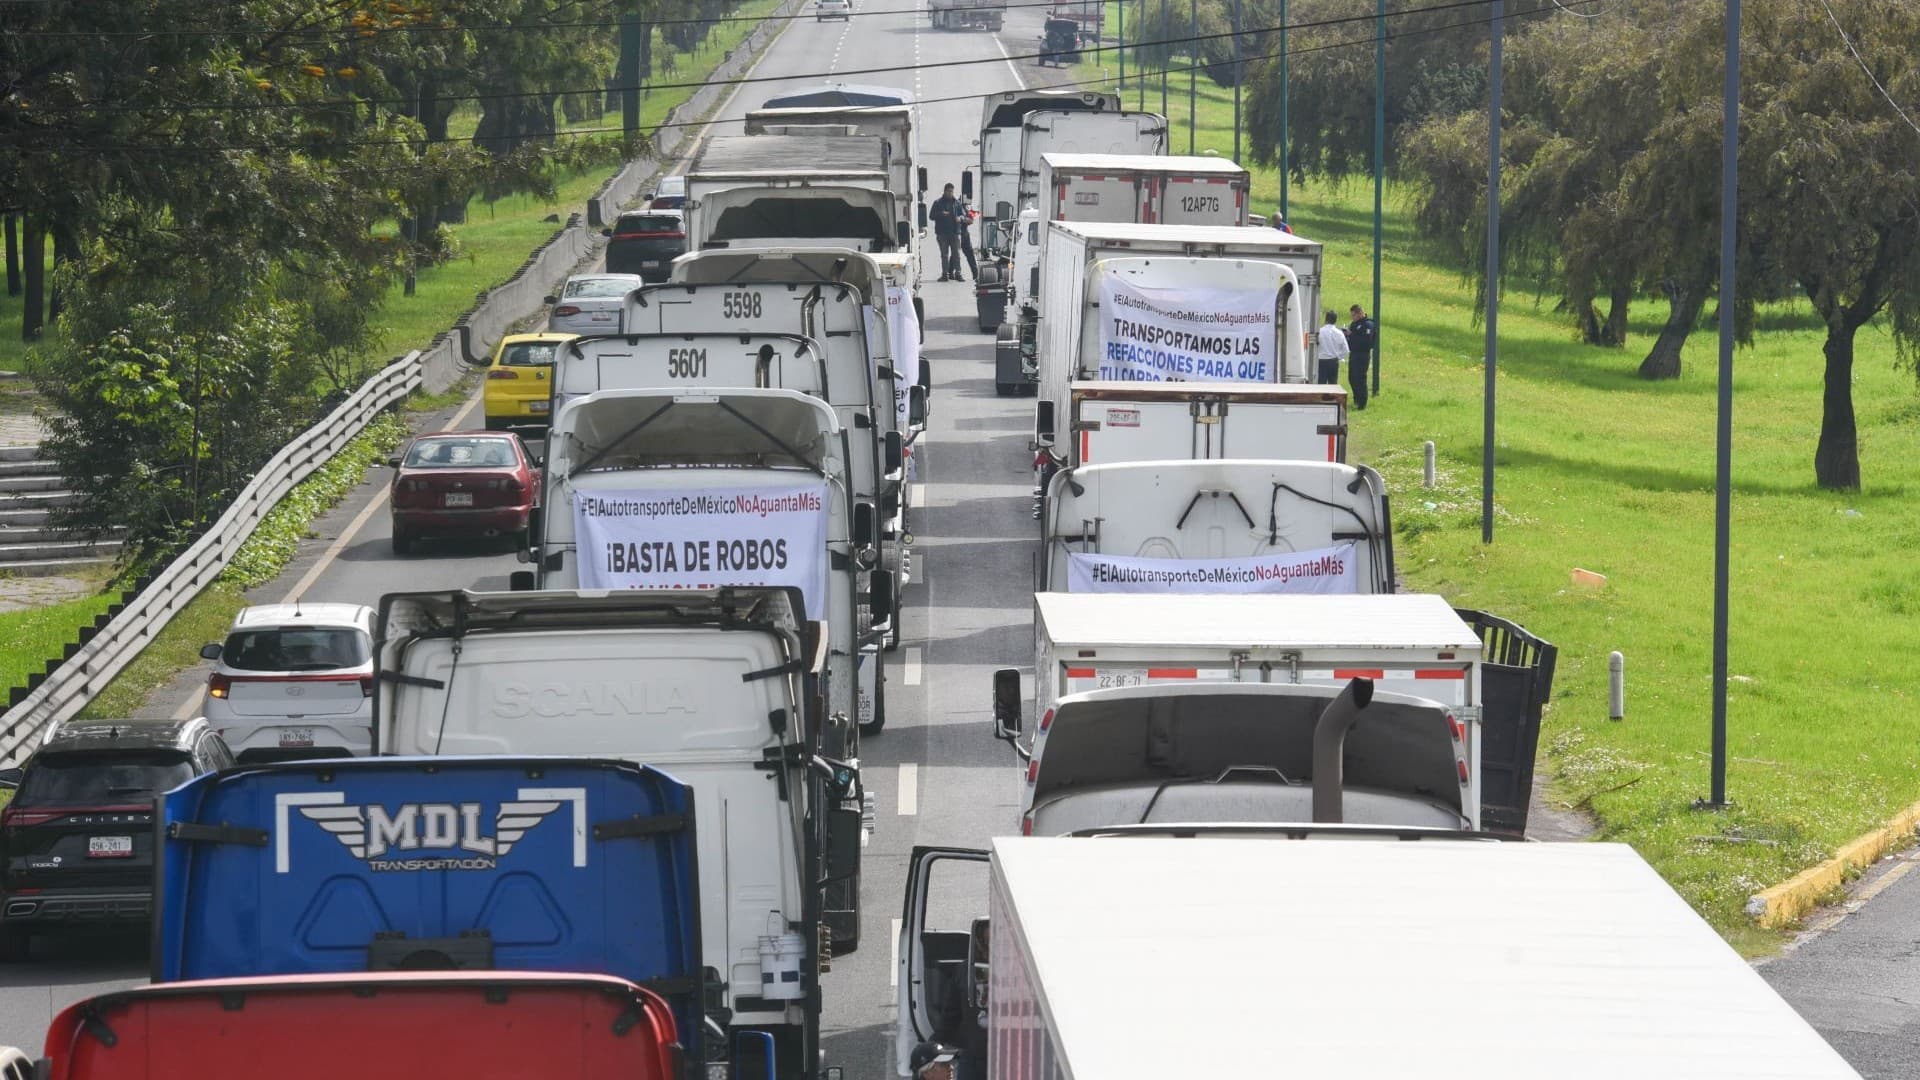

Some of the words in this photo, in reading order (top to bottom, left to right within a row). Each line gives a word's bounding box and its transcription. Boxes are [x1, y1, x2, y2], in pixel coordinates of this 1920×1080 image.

[1181, 196, 1219, 212] 12AP7G
[723, 291, 762, 319] 5598
[1113, 318, 1231, 355] TRANSPORTAMOS
[1235, 337, 1260, 355] LAS
[668, 348, 707, 378] 5601
[1107, 342, 1193, 374] REFACCIONES
[1197, 359, 1233, 378] PARA
[1237, 361, 1266, 380] QUE
[581, 493, 821, 520] #ElAutotransporteDeMéxicoNoAguantaMás
[607, 541, 678, 573] ¡BASTA
[684, 540, 710, 572] DE
[716, 538, 787, 571] ROBOS
[1092, 556, 1344, 586] #ElAutotransporteDeMéxicoNoAguantaMás
[490, 682, 697, 719] SCANIA
[70, 815, 151, 824] CHIREY
[366, 802, 496, 858] MDL
[368, 858, 496, 873] TRANSPORTACIÓN
